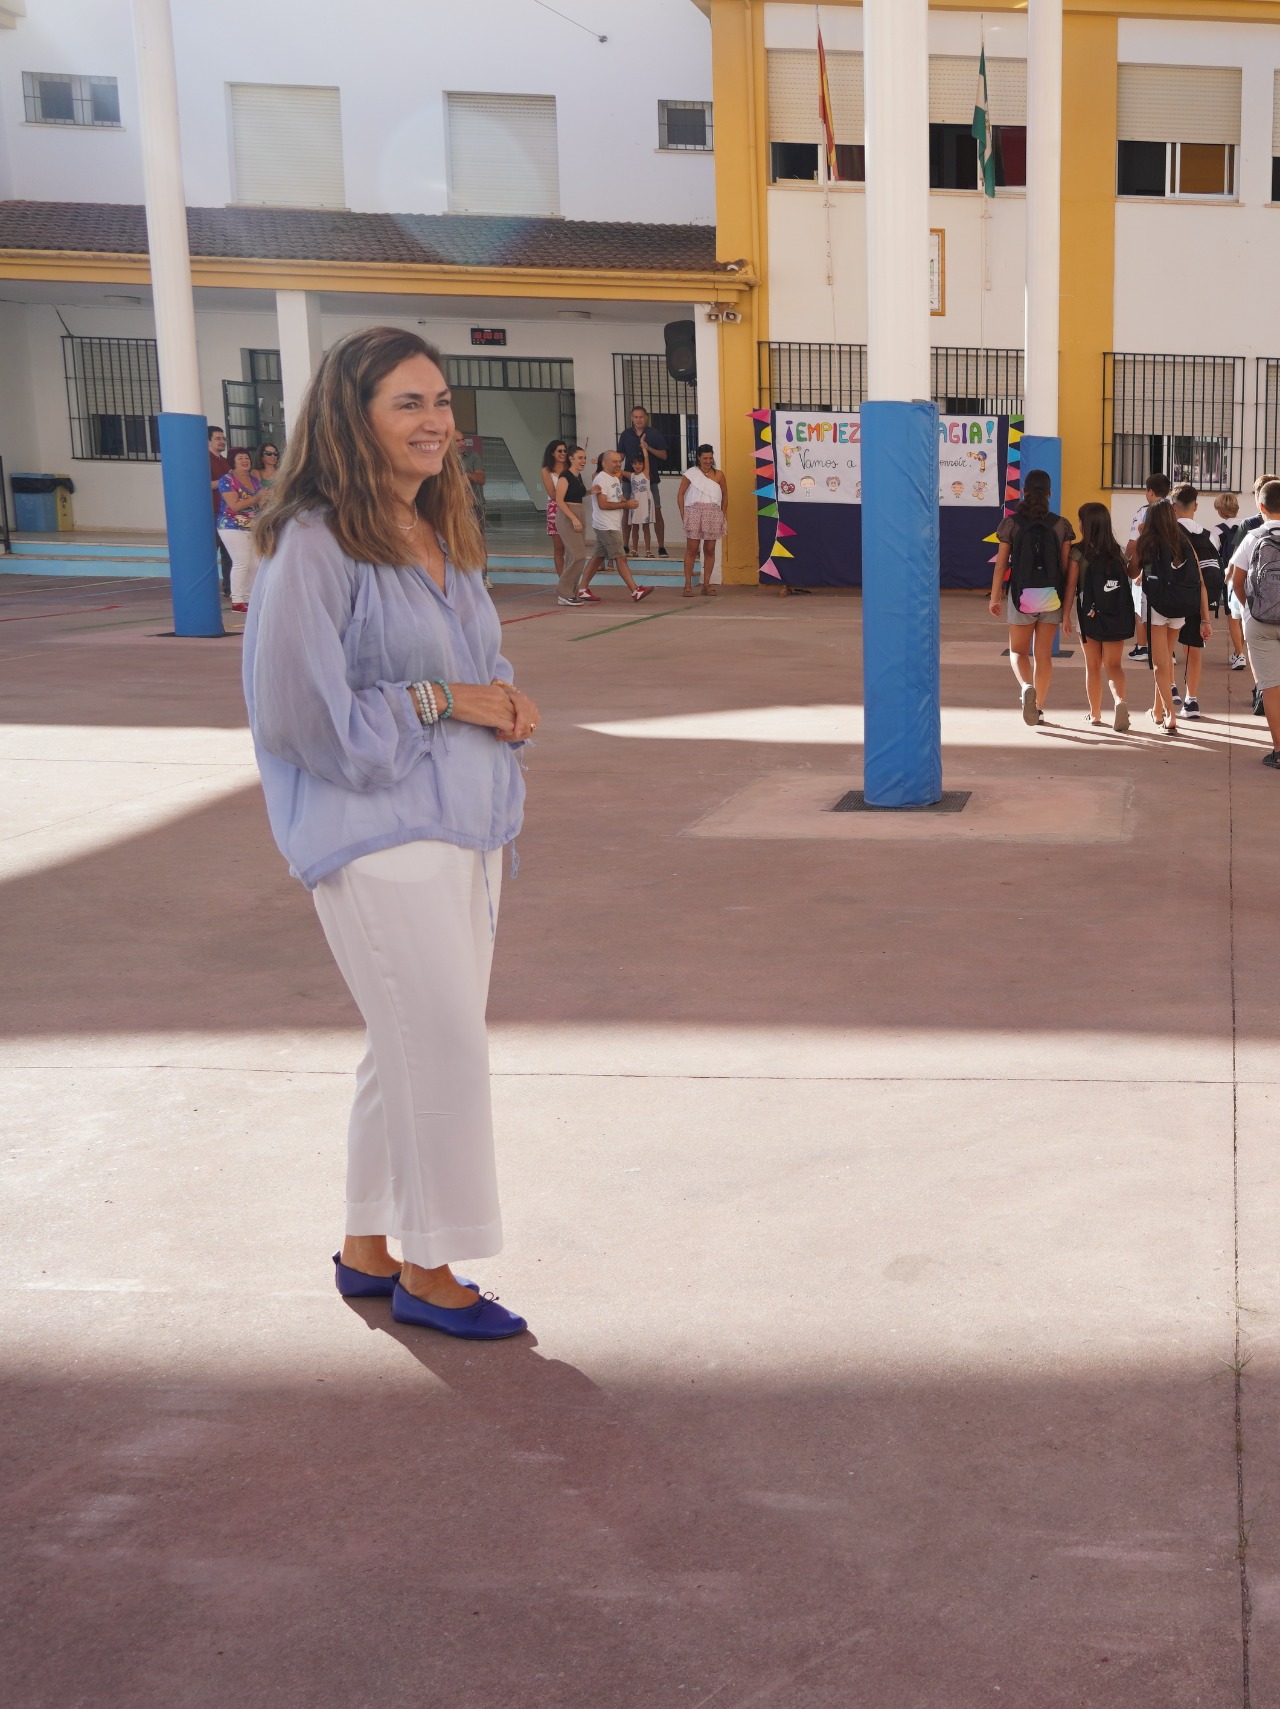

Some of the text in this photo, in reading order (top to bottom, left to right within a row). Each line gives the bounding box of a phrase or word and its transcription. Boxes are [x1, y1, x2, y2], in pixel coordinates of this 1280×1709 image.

[785, 420, 995, 444] ¡EMPIEZ AGIA!
[799, 449, 838, 469] Vamos
[847, 460, 857, 468] a
